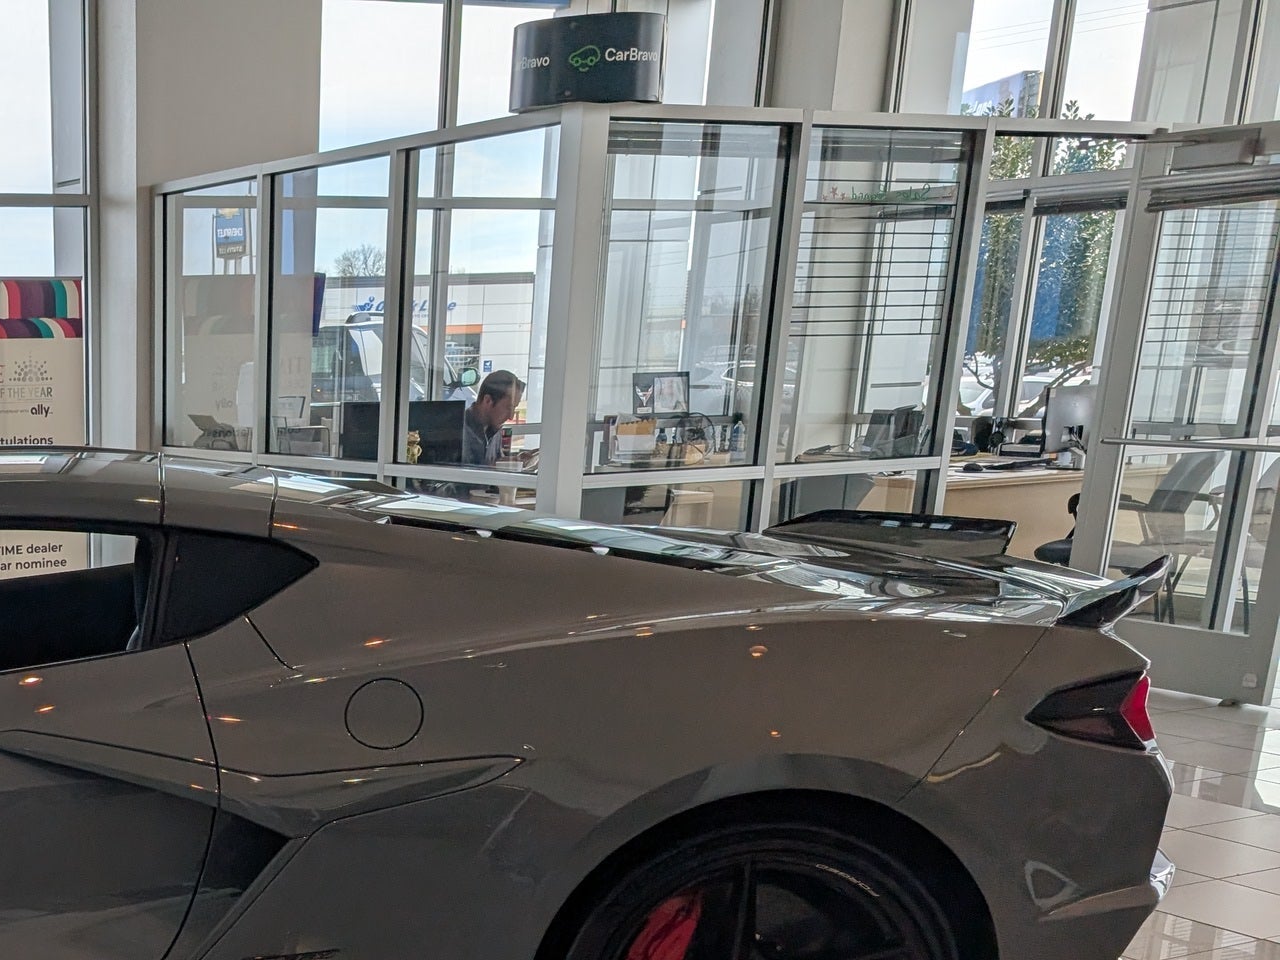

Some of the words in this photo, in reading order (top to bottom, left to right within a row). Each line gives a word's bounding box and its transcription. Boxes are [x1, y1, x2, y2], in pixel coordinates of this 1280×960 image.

[605, 47, 658, 62] CarBravo
[7, 387, 26, 398] THE
[28, 386, 53, 398] YEAR
[26, 543, 63, 554] dealer
[15, 557, 67, 570] nominee
